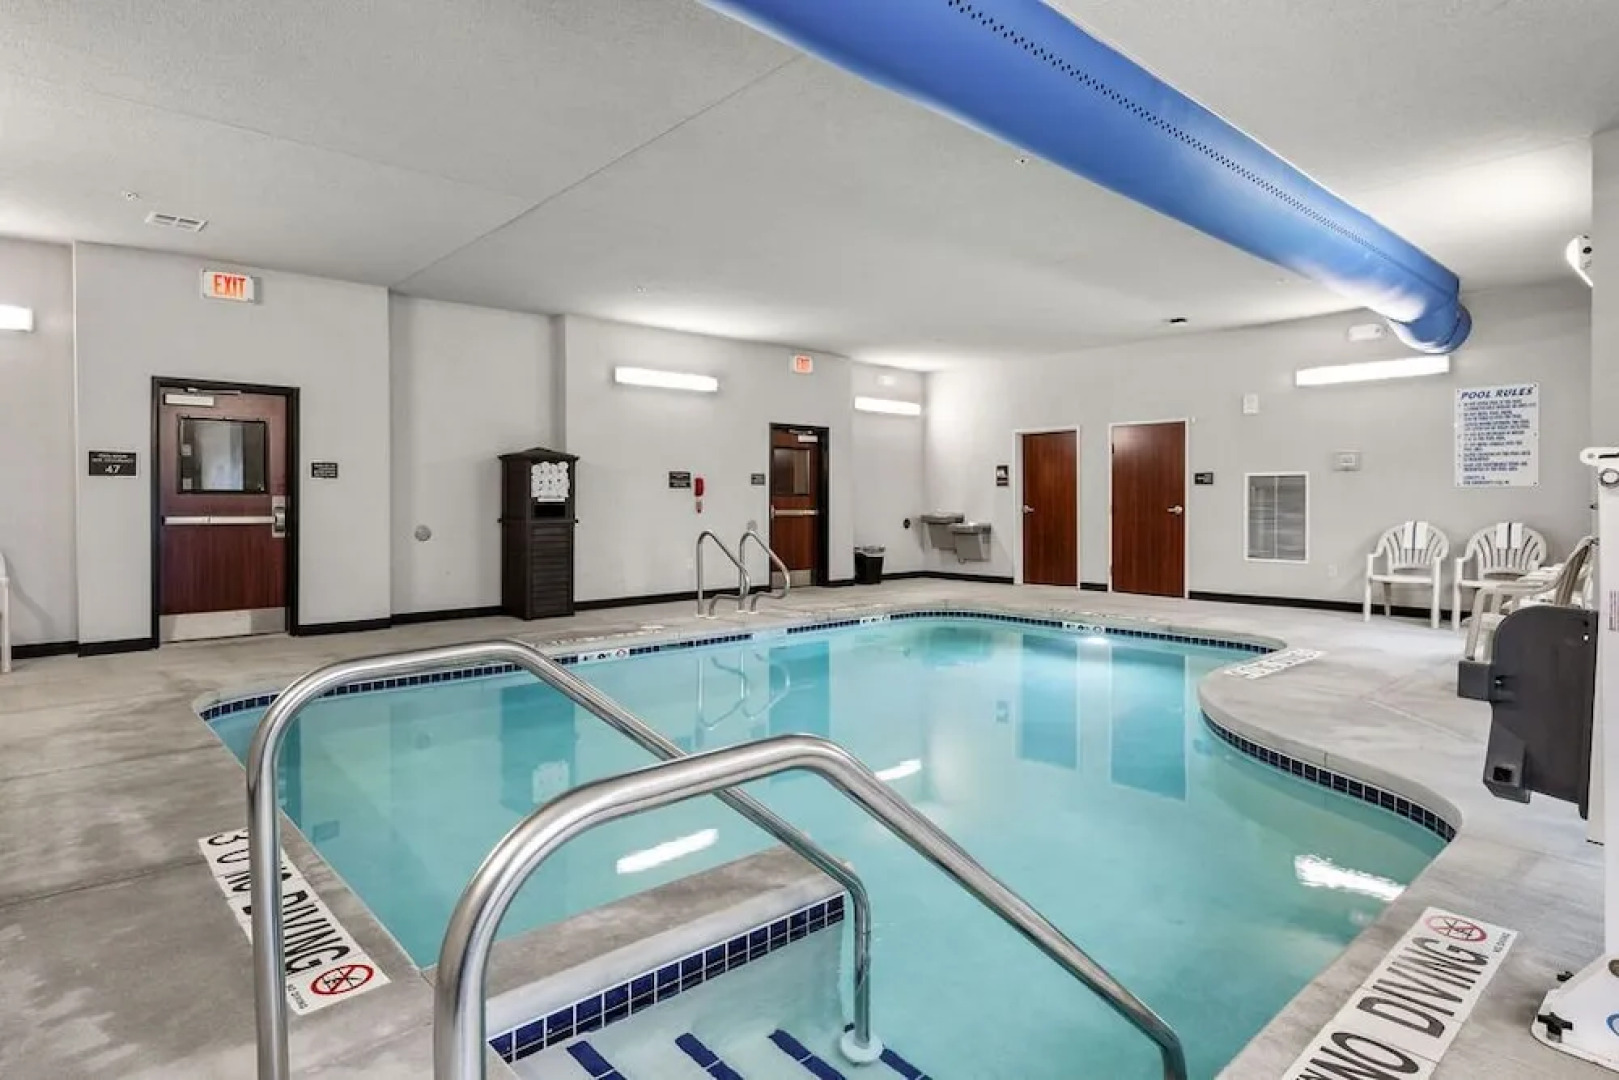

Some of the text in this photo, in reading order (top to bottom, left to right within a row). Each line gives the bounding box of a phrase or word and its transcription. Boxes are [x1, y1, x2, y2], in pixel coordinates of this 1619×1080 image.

[213, 273, 246, 298] EXIT
[1461, 386, 1534, 400] POOL RULES
[104, 464, 121, 474] 47
[1356, 936, 1489, 1039] DIVING
